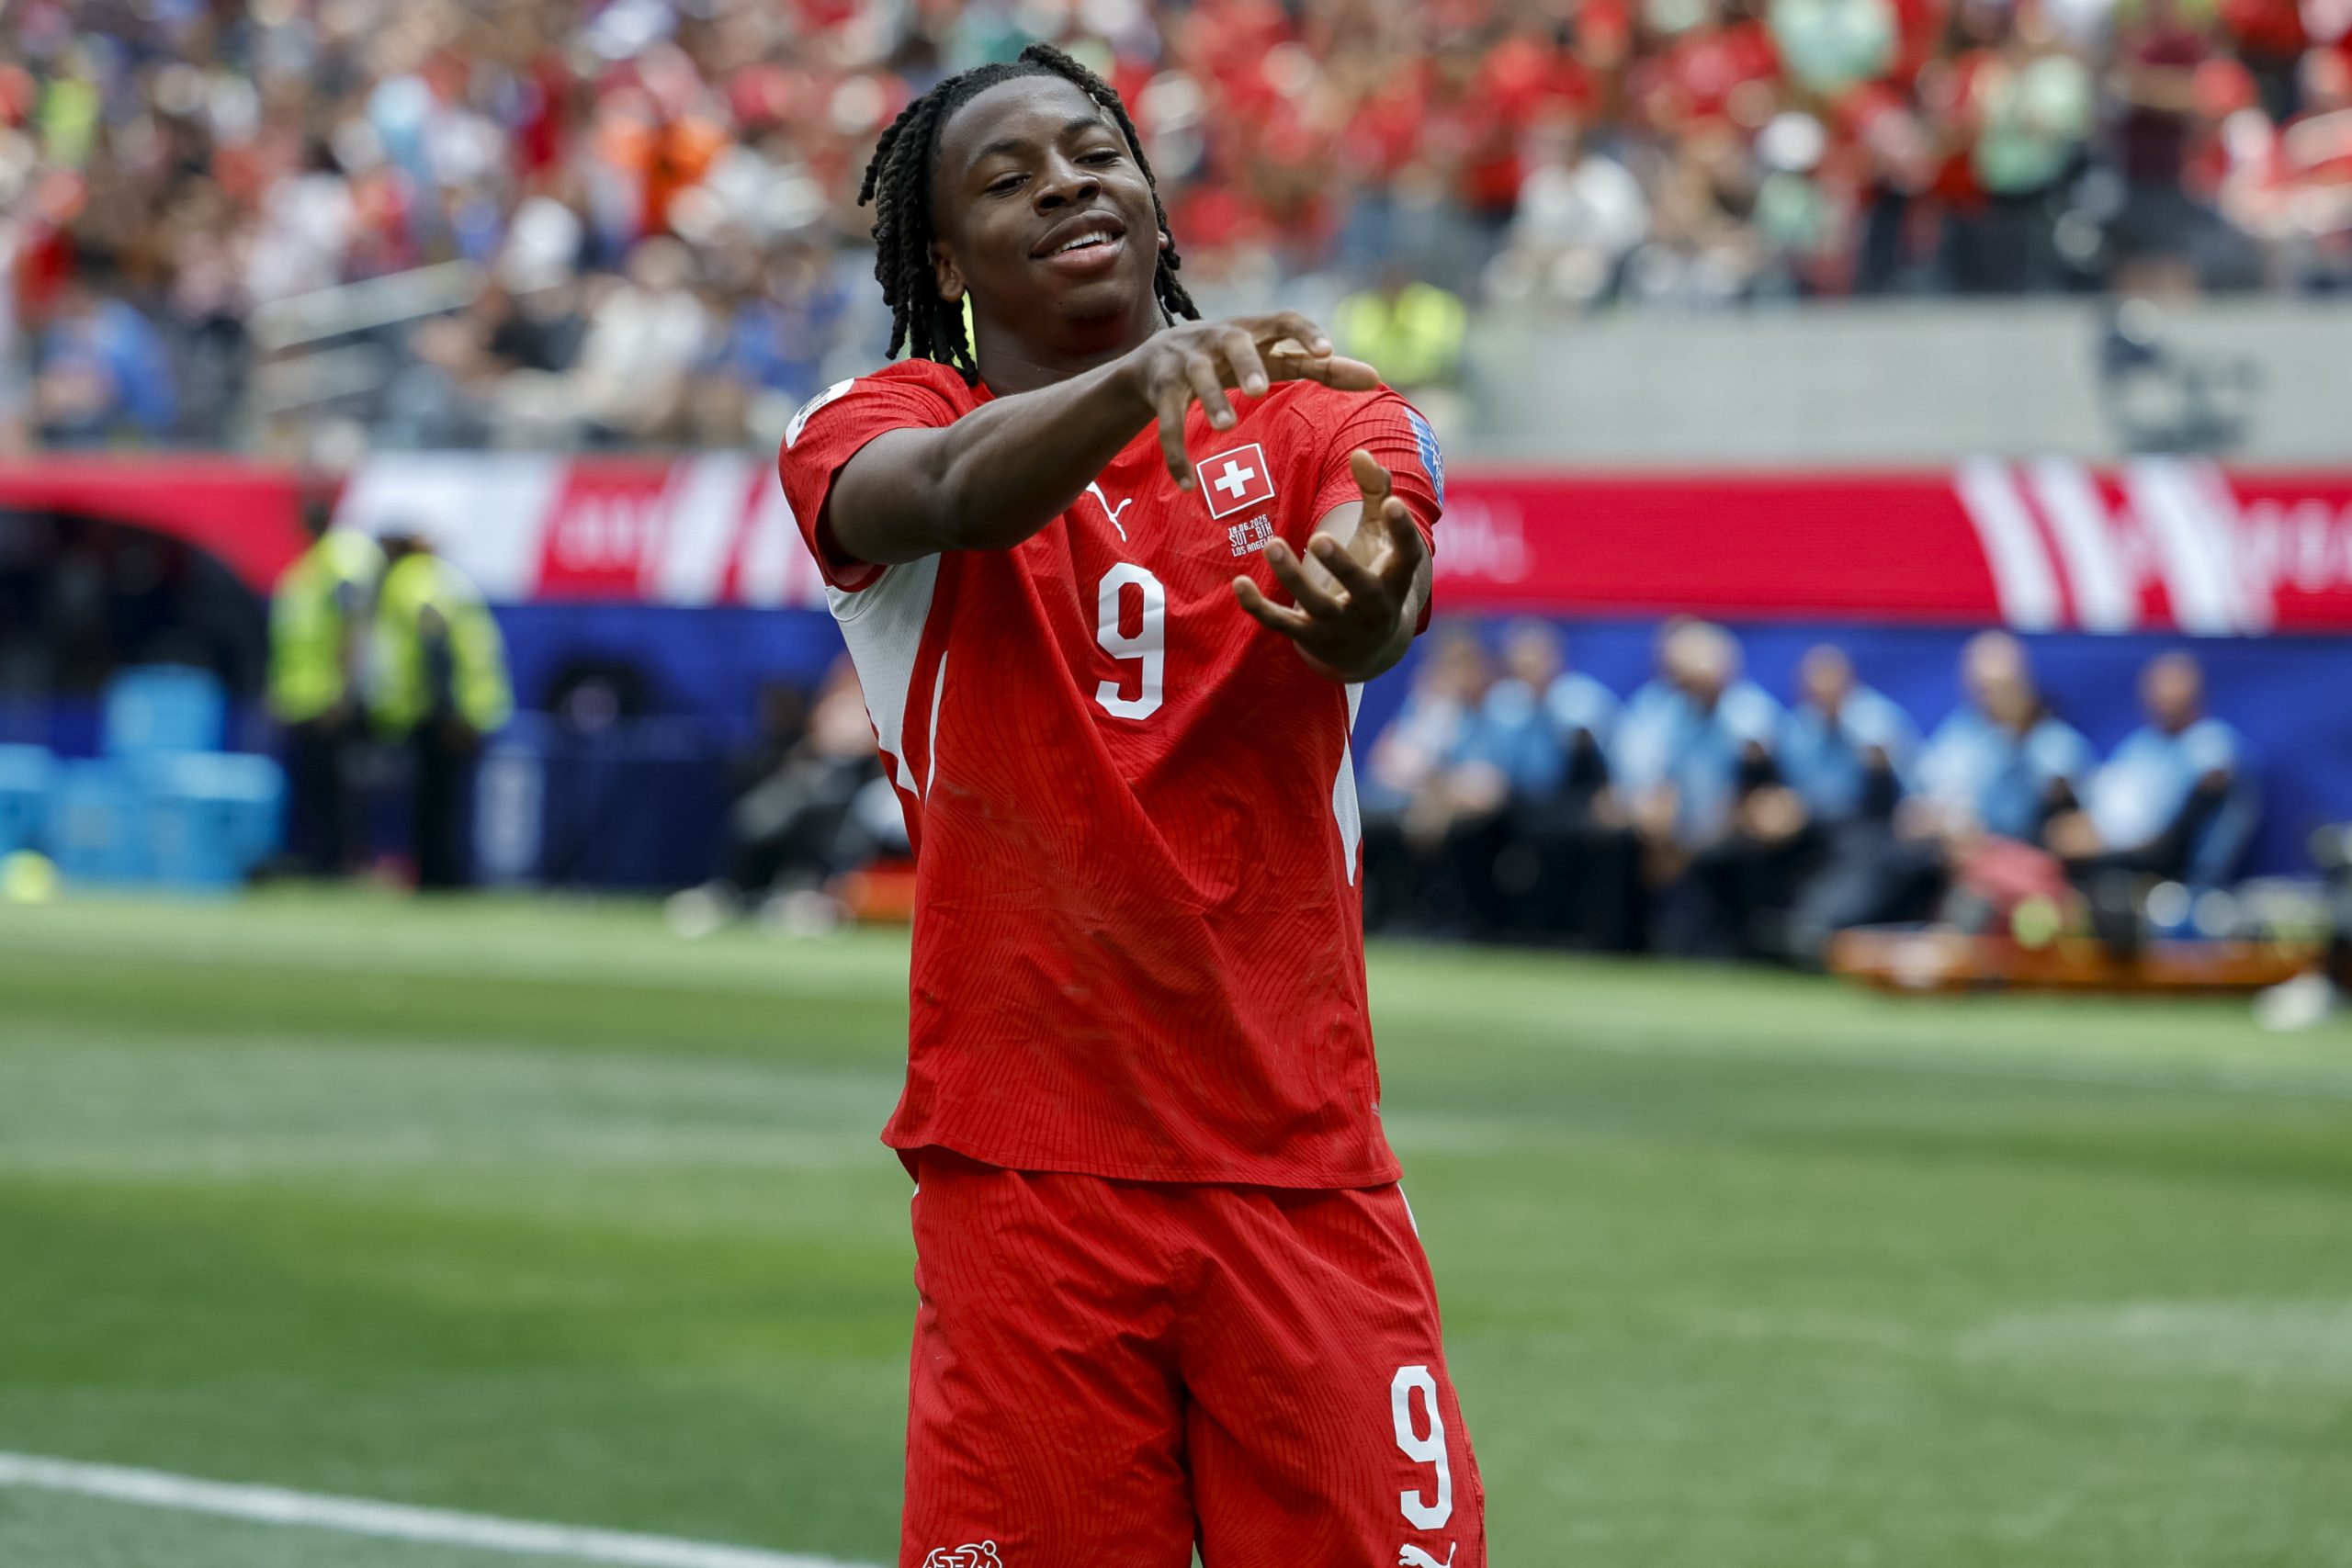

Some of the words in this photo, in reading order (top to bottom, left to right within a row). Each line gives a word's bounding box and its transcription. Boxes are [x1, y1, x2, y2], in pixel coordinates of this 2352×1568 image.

[1228, 514, 1267, 535] 18.06.2026
[1229, 531, 1248, 547] SUI
[1255, 522, 1273, 539] BIH
[1231, 546, 1247, 558] LOS
[1095, 562, 1165, 720] 9
[1390, 1365, 1453, 1530] 9
